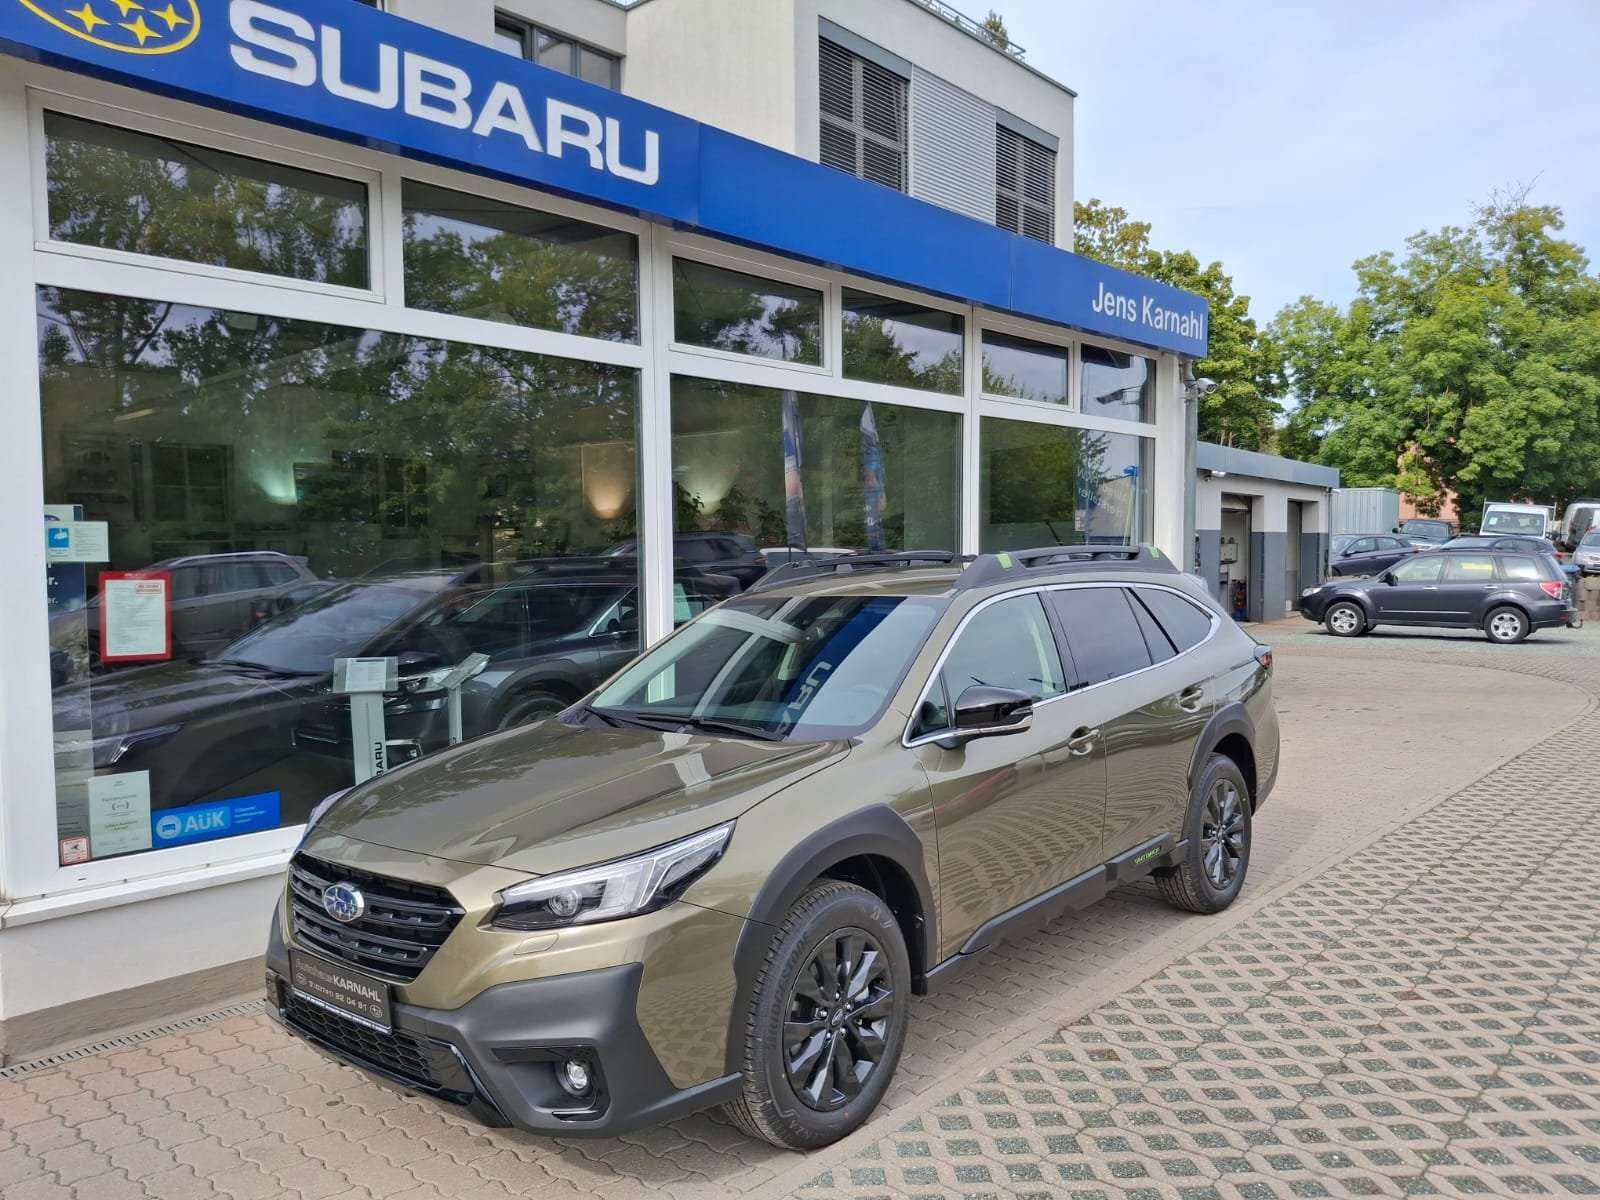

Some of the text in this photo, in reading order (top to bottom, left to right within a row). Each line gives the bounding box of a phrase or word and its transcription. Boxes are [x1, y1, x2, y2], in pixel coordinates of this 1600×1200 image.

[229, 0, 659, 186] SUBARU
[1092, 281, 1204, 341] Jens Karnahl
[333, 975, 382, 1003] KARNAHL
